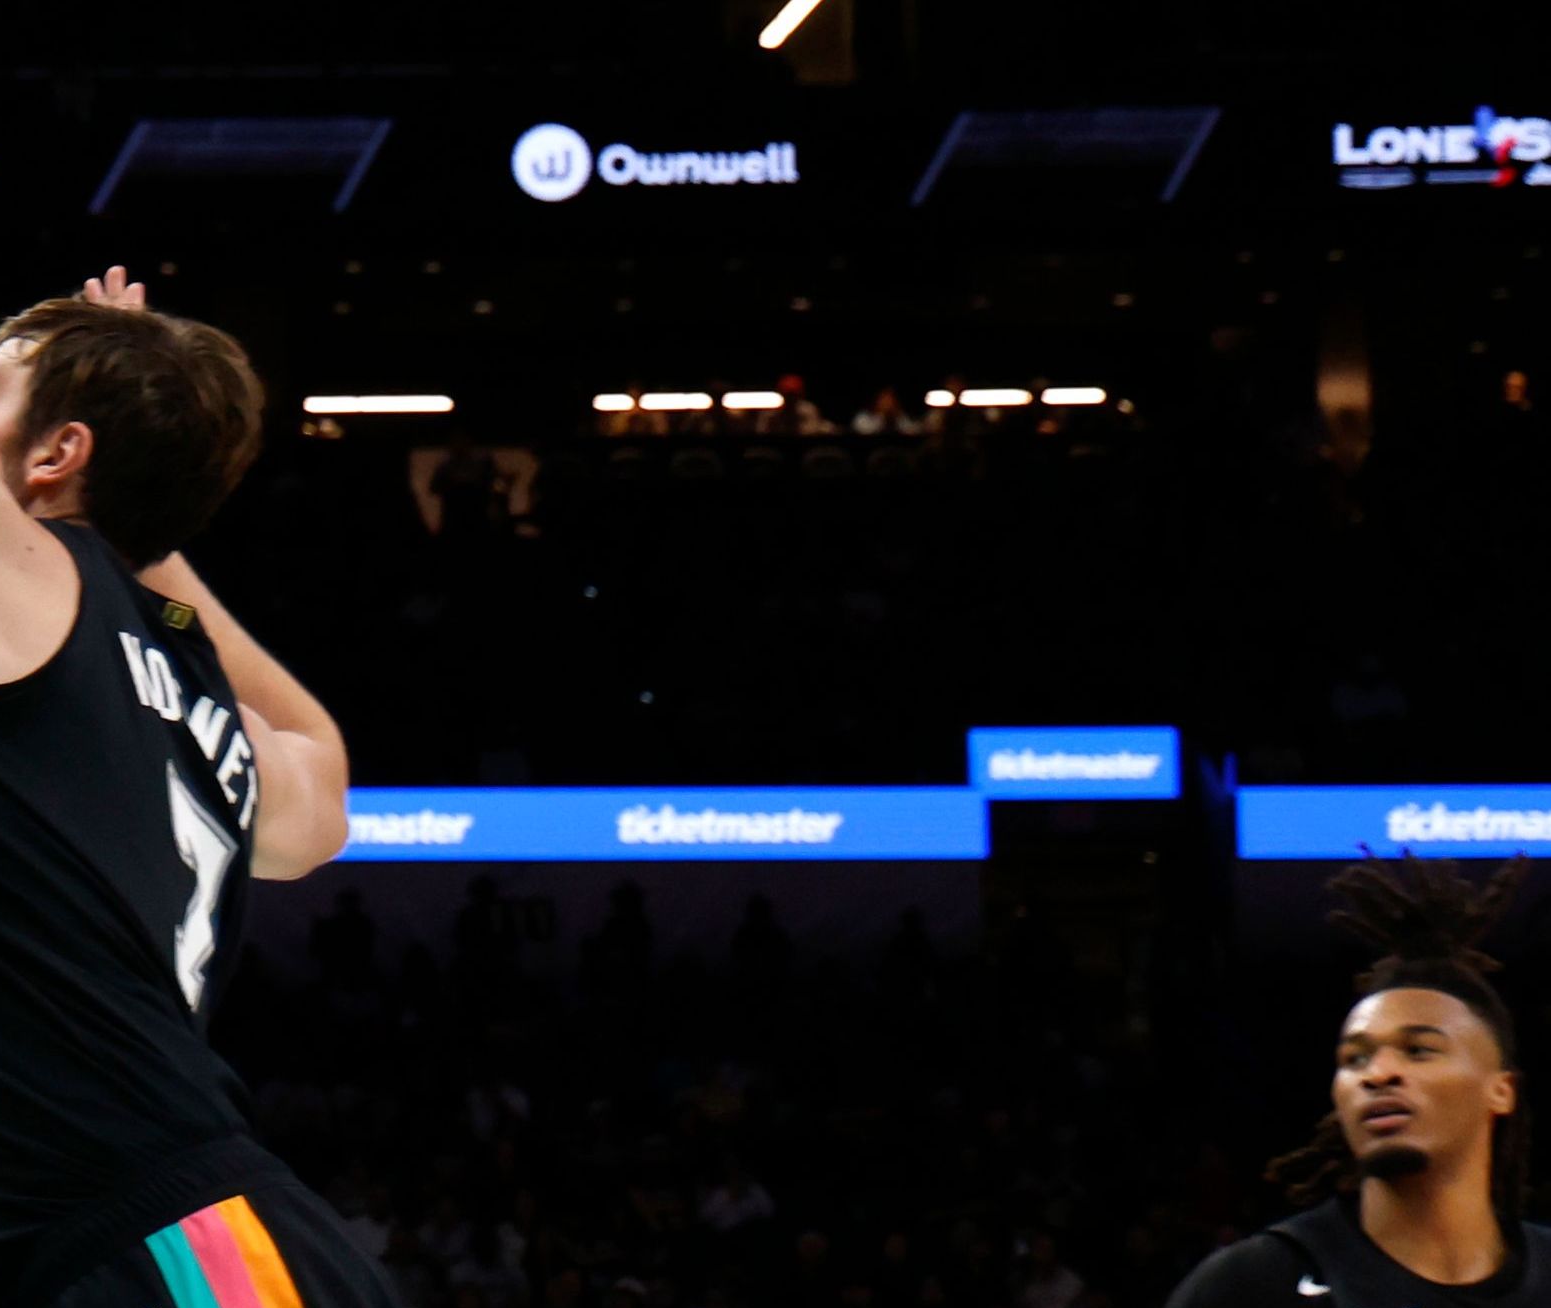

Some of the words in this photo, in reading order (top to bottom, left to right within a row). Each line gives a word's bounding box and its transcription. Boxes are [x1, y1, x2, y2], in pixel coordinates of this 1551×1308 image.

[599, 142, 798, 185] Ownwell
[1333, 122, 1481, 165] LONE
[118, 631, 259, 832] ONE
[989, 749, 1161, 781] ticketmaster
[616, 804, 843, 845] ticketmaster
[1386, 801, 1551, 843] ticketma
